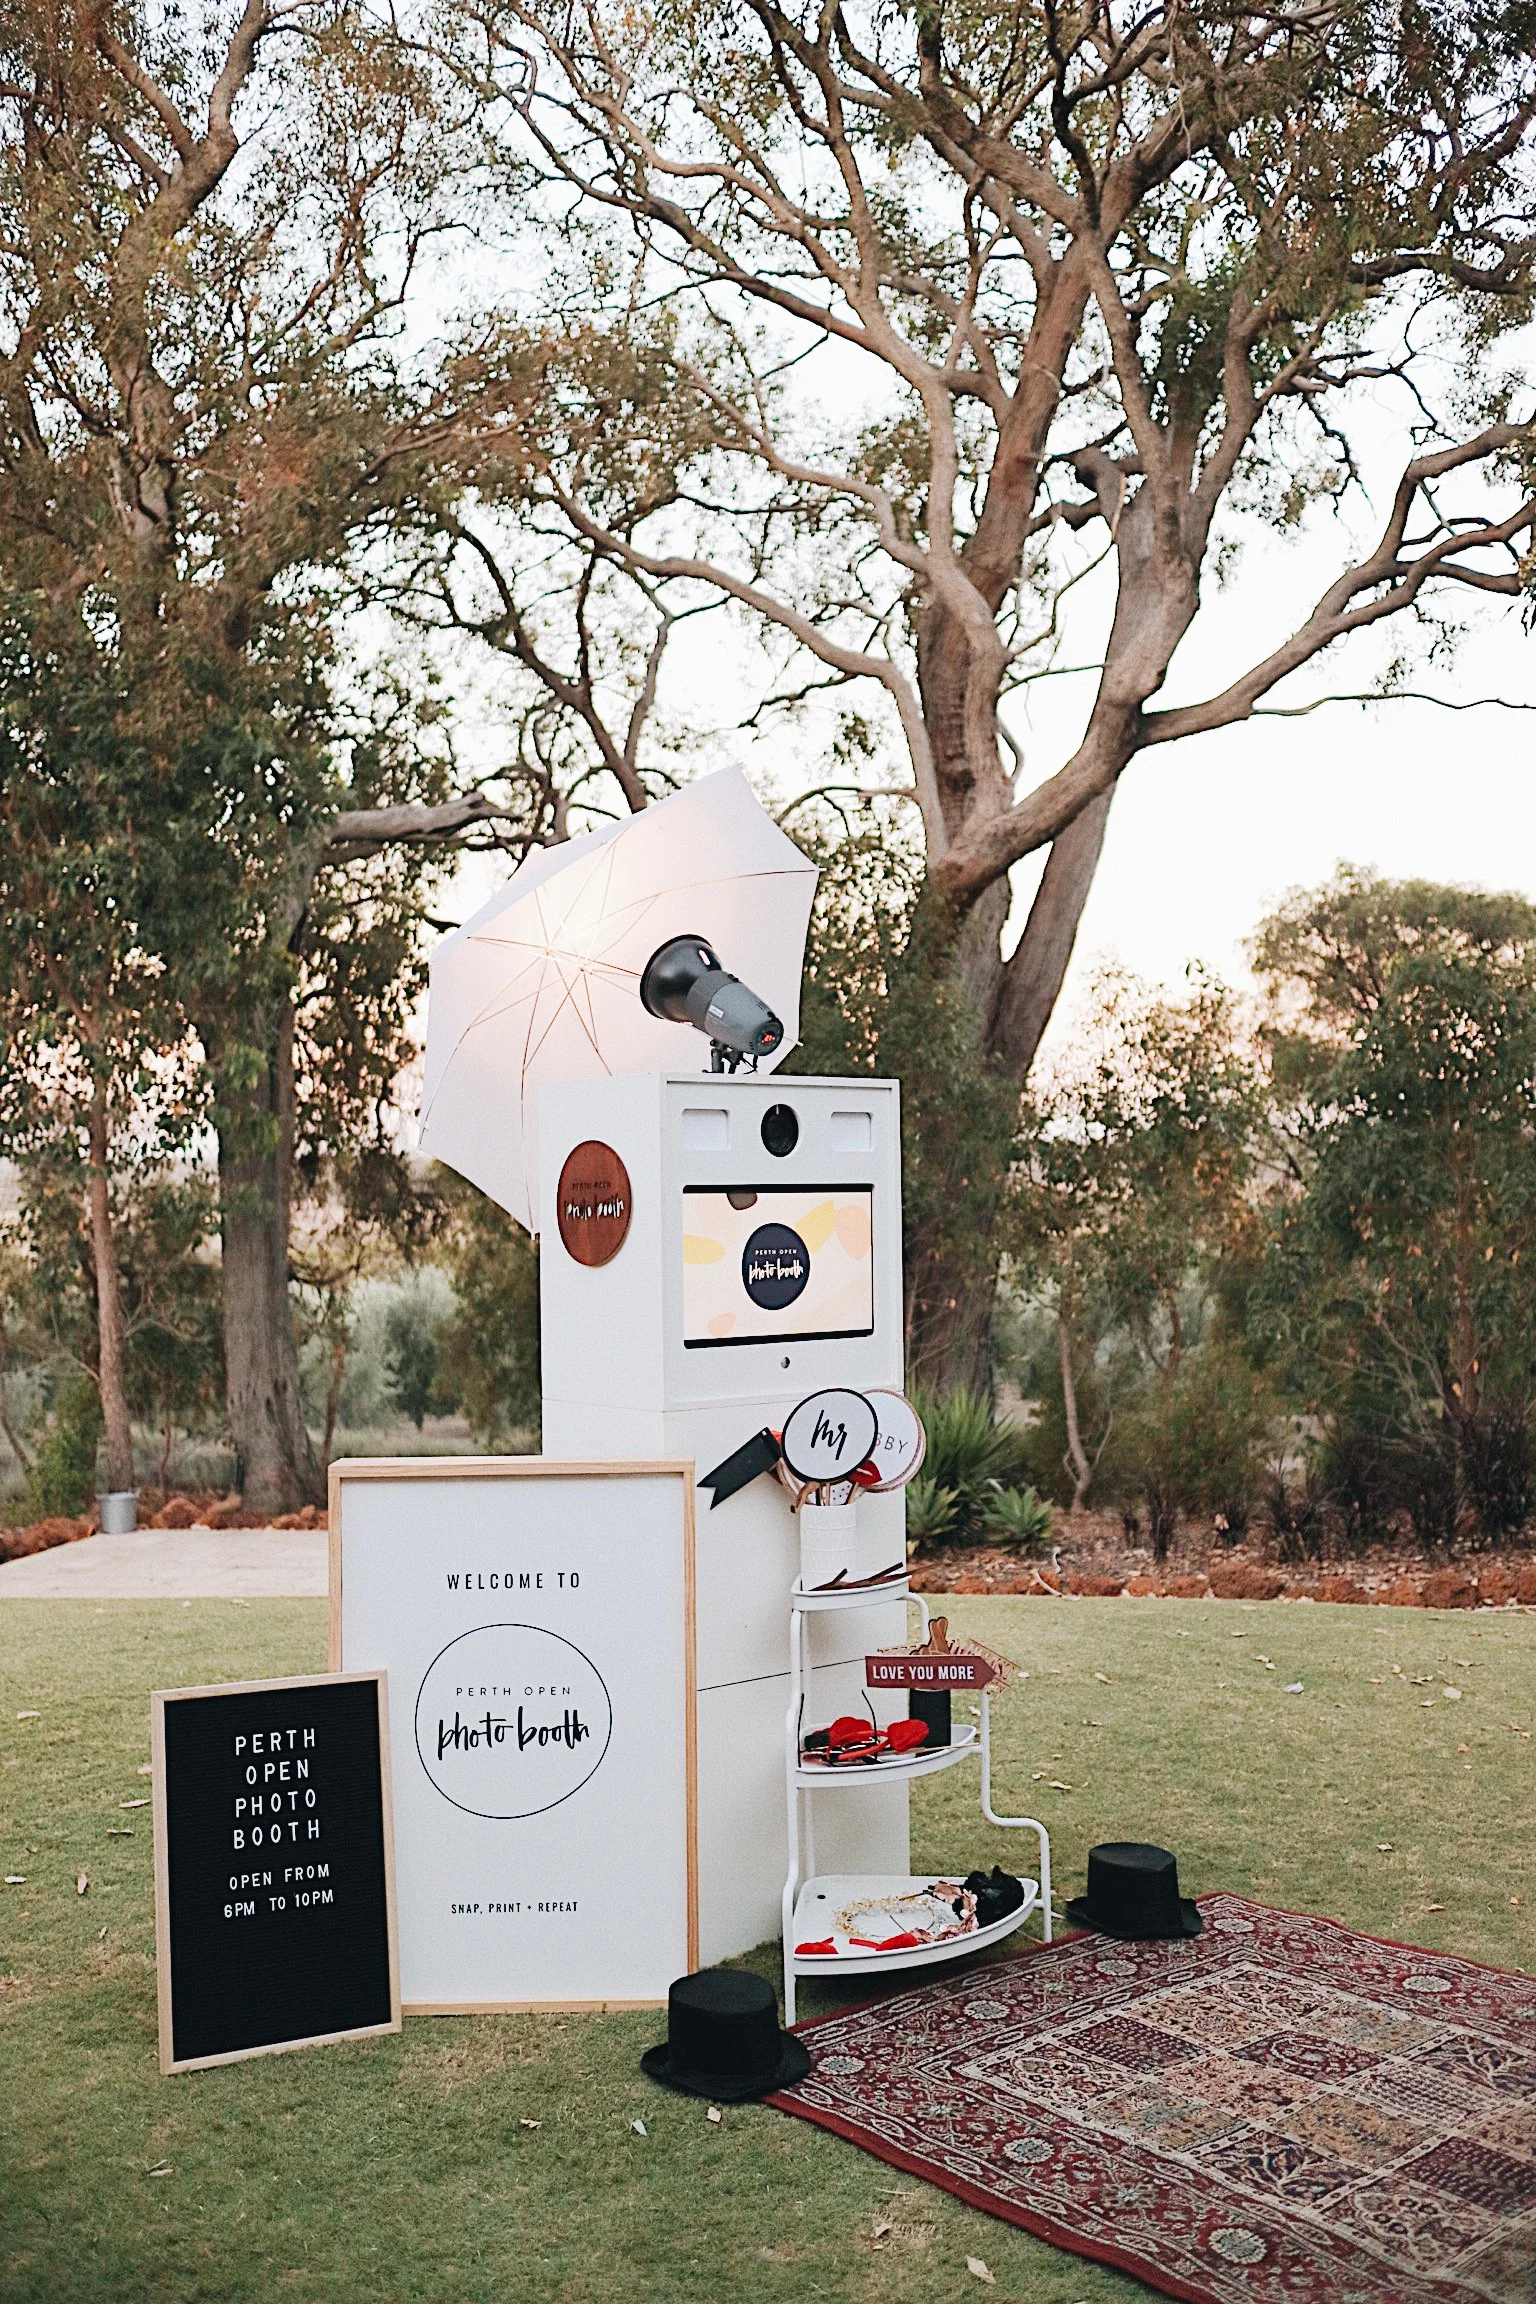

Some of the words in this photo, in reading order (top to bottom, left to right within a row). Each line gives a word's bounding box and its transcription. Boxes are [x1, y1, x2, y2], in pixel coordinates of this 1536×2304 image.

[748, 1260, 777, 1285] photo
[776, 1257, 804, 1280] booth
[446, 1572, 544, 1590] WELCOME
[557, 1572, 581, 1589] TO
[872, 1665, 905, 1680] LOVE
[908, 1665, 934, 1680] YOU
[938, 1665, 975, 1680] MORE
[456, 1686, 511, 1697] PERTH
[524, 1686, 571, 1696] OPEN
[235, 1728, 316, 1756] PERTH
[437, 1711, 514, 1761] photo
[517, 1705, 590, 1752] booth
[245, 1758, 309, 1785] OPEN
[235, 1788, 317, 1818] PHOTO
[233, 1818, 320, 1850] BOOTH
[229, 1871, 272, 1891] OPEN
[284, 1863, 330, 1883] FROM
[223, 1900, 255, 1919] 6PM
[269, 1896, 286, 1912] TO
[294, 1889, 334, 1908] 10PM
[451, 1903, 483, 1915] SNAP,
[488, 1902, 521, 1913] PRINT
[538, 1901, 578, 1913] REPEAT
